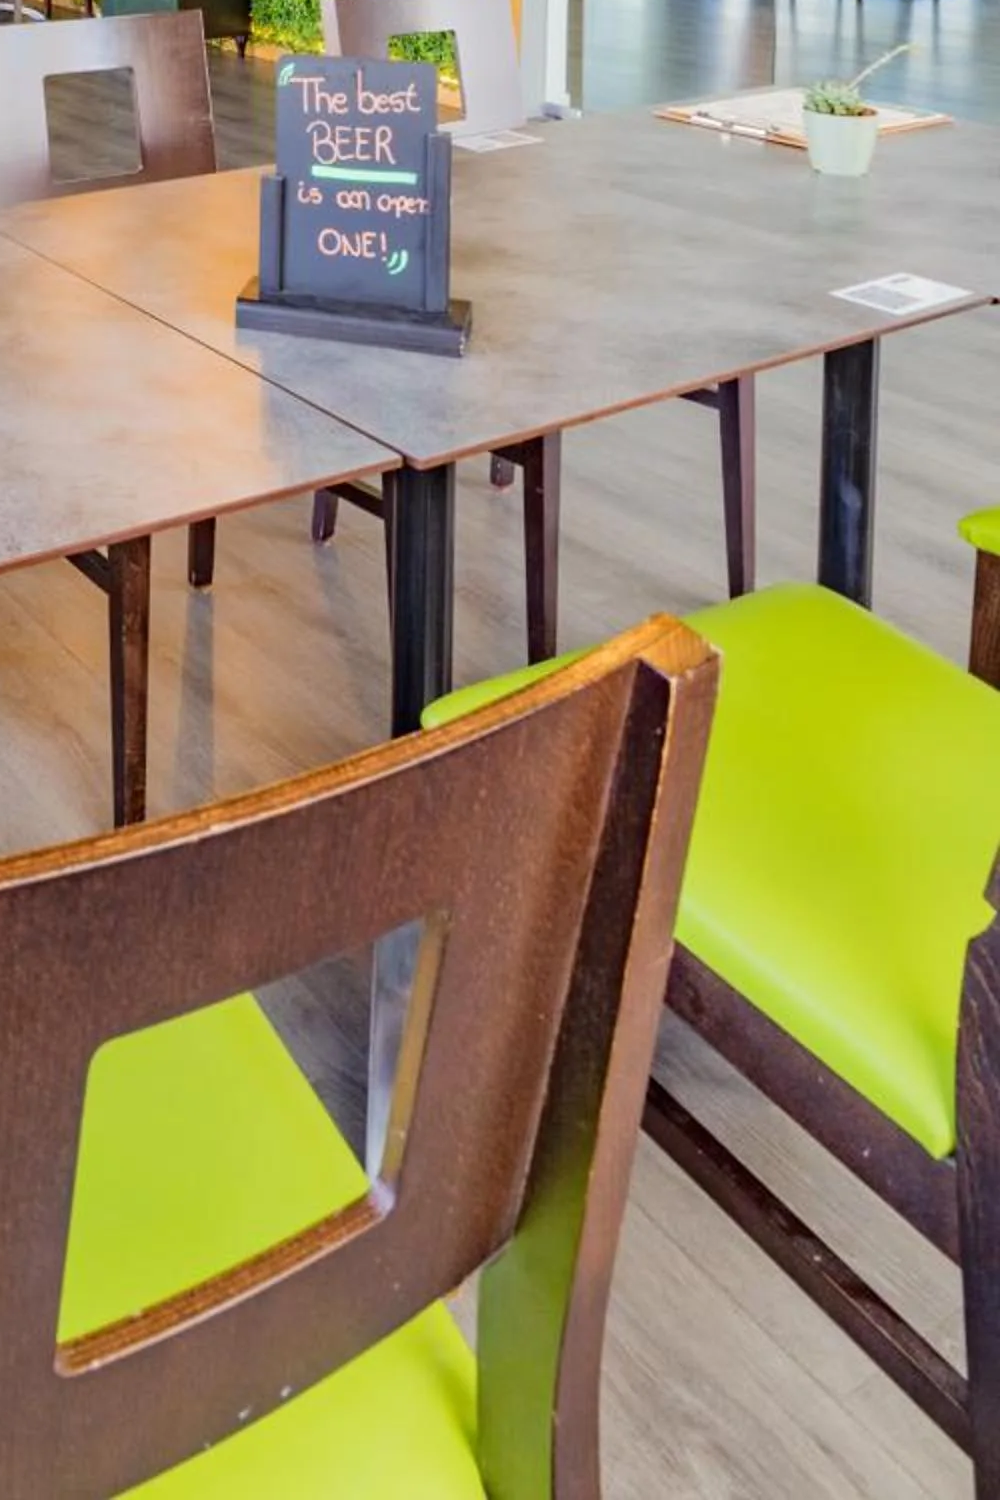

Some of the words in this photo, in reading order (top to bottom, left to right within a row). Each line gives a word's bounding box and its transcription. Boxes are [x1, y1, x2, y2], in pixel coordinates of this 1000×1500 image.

[356, 68, 421, 114] best
[306, 120, 396, 165] BEER
[297, 180, 323, 204] is
[336, 190, 371, 211] an
